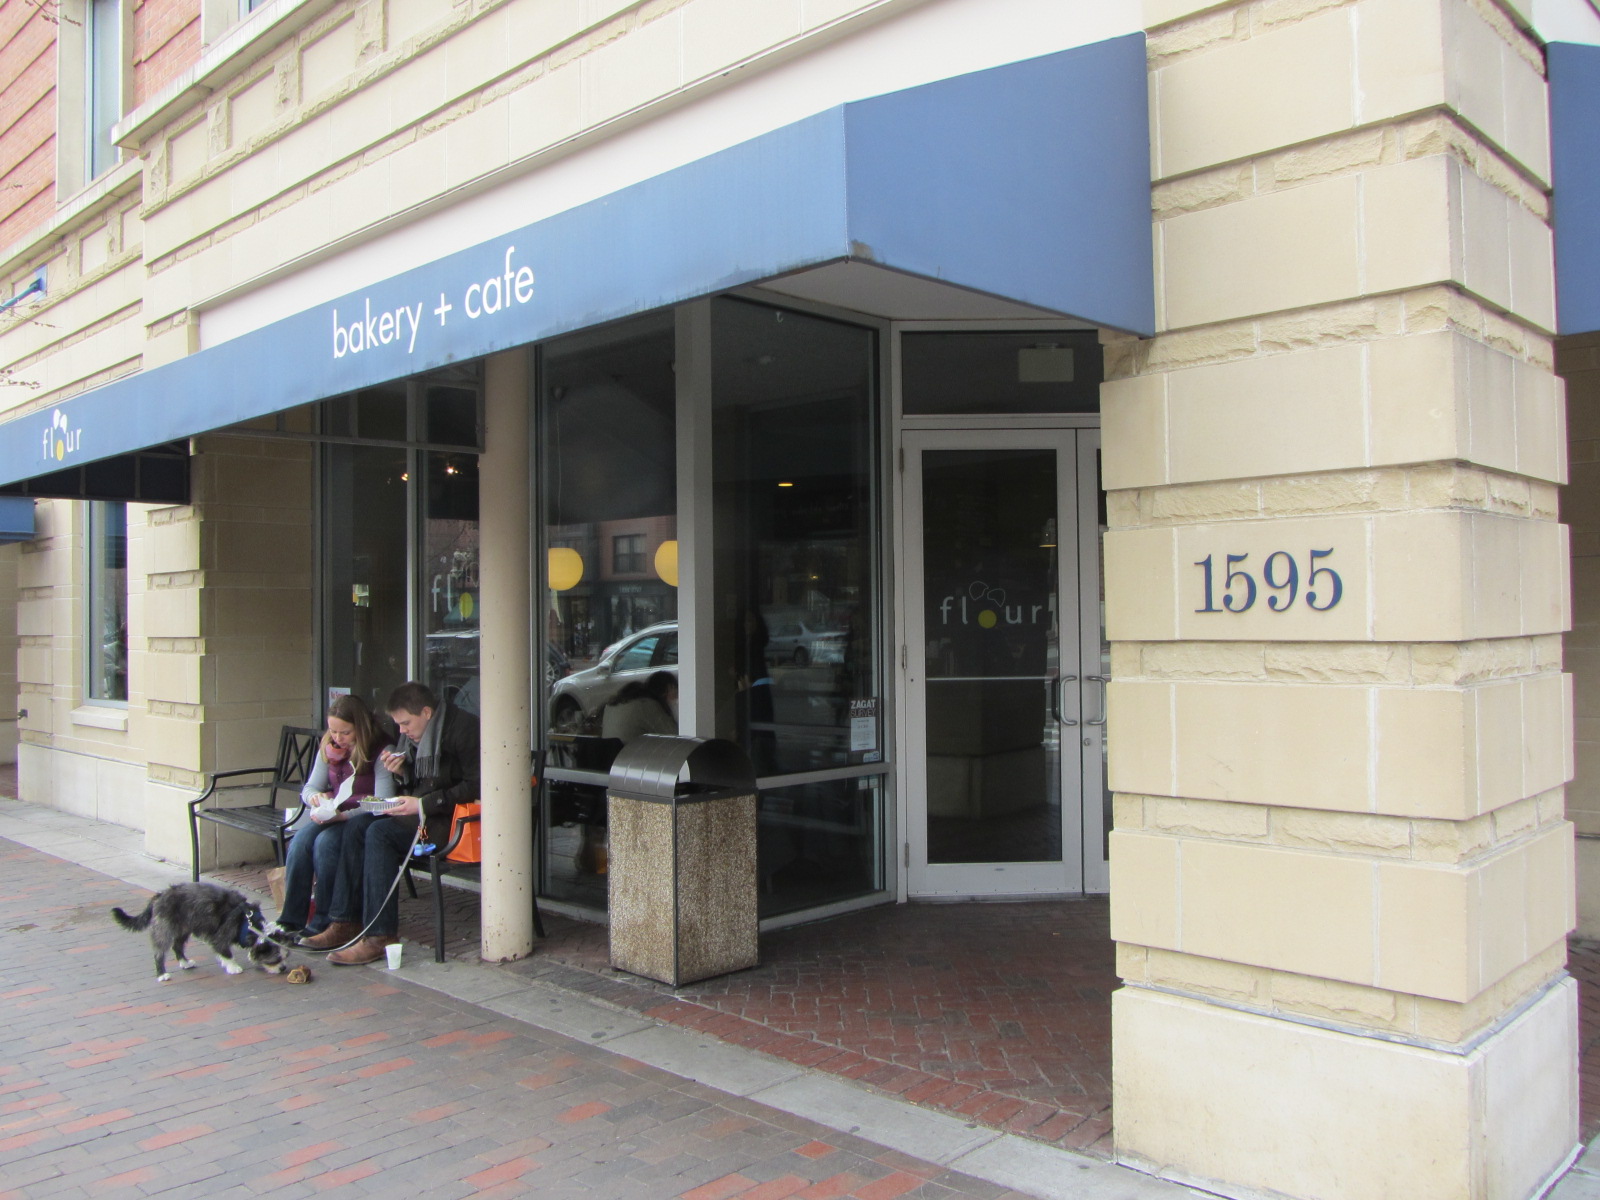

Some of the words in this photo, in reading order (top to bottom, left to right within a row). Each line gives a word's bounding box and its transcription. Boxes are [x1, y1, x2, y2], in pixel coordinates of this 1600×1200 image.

[333, 297, 423, 359] bakery
[434, 292, 452, 327] +
[465, 245, 535, 319] cafe
[42, 426, 82, 461] flour
[1194, 547, 1343, 614] 1595
[939, 595, 1043, 629] flour
[850, 699, 876, 710] ZAGAT
[850, 708, 876, 718] SURVEY
